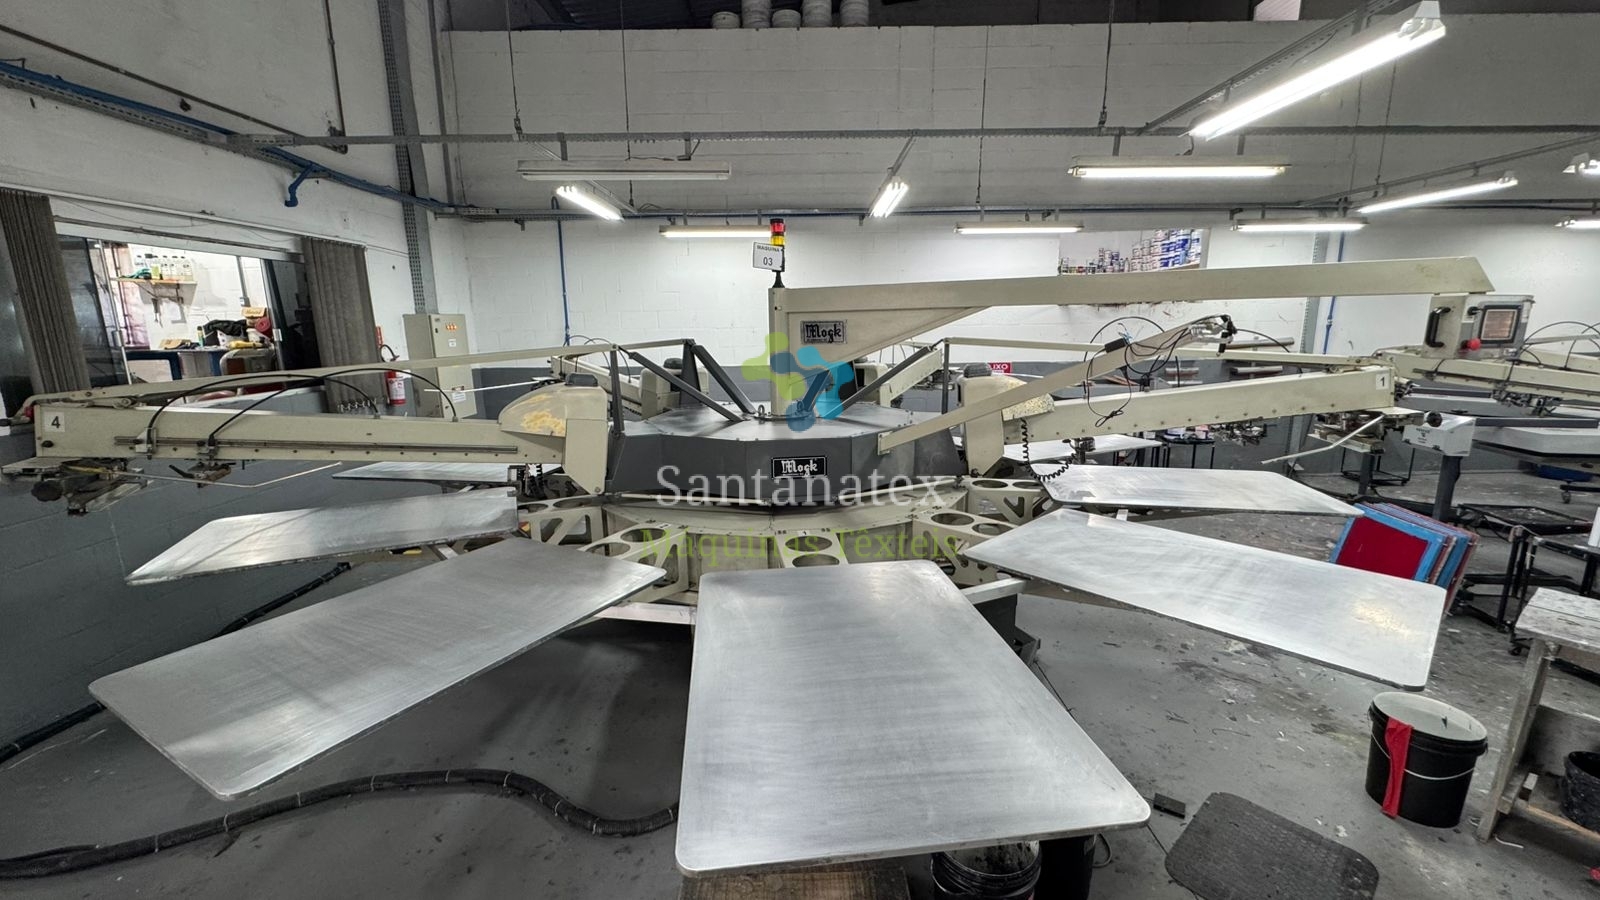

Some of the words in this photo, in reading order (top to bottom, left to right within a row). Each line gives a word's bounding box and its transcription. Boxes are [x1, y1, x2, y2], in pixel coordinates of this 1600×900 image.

[763, 256, 773, 266] 03
[1380, 376, 1385, 387] 1
[51, 415, 61, 429] 4
